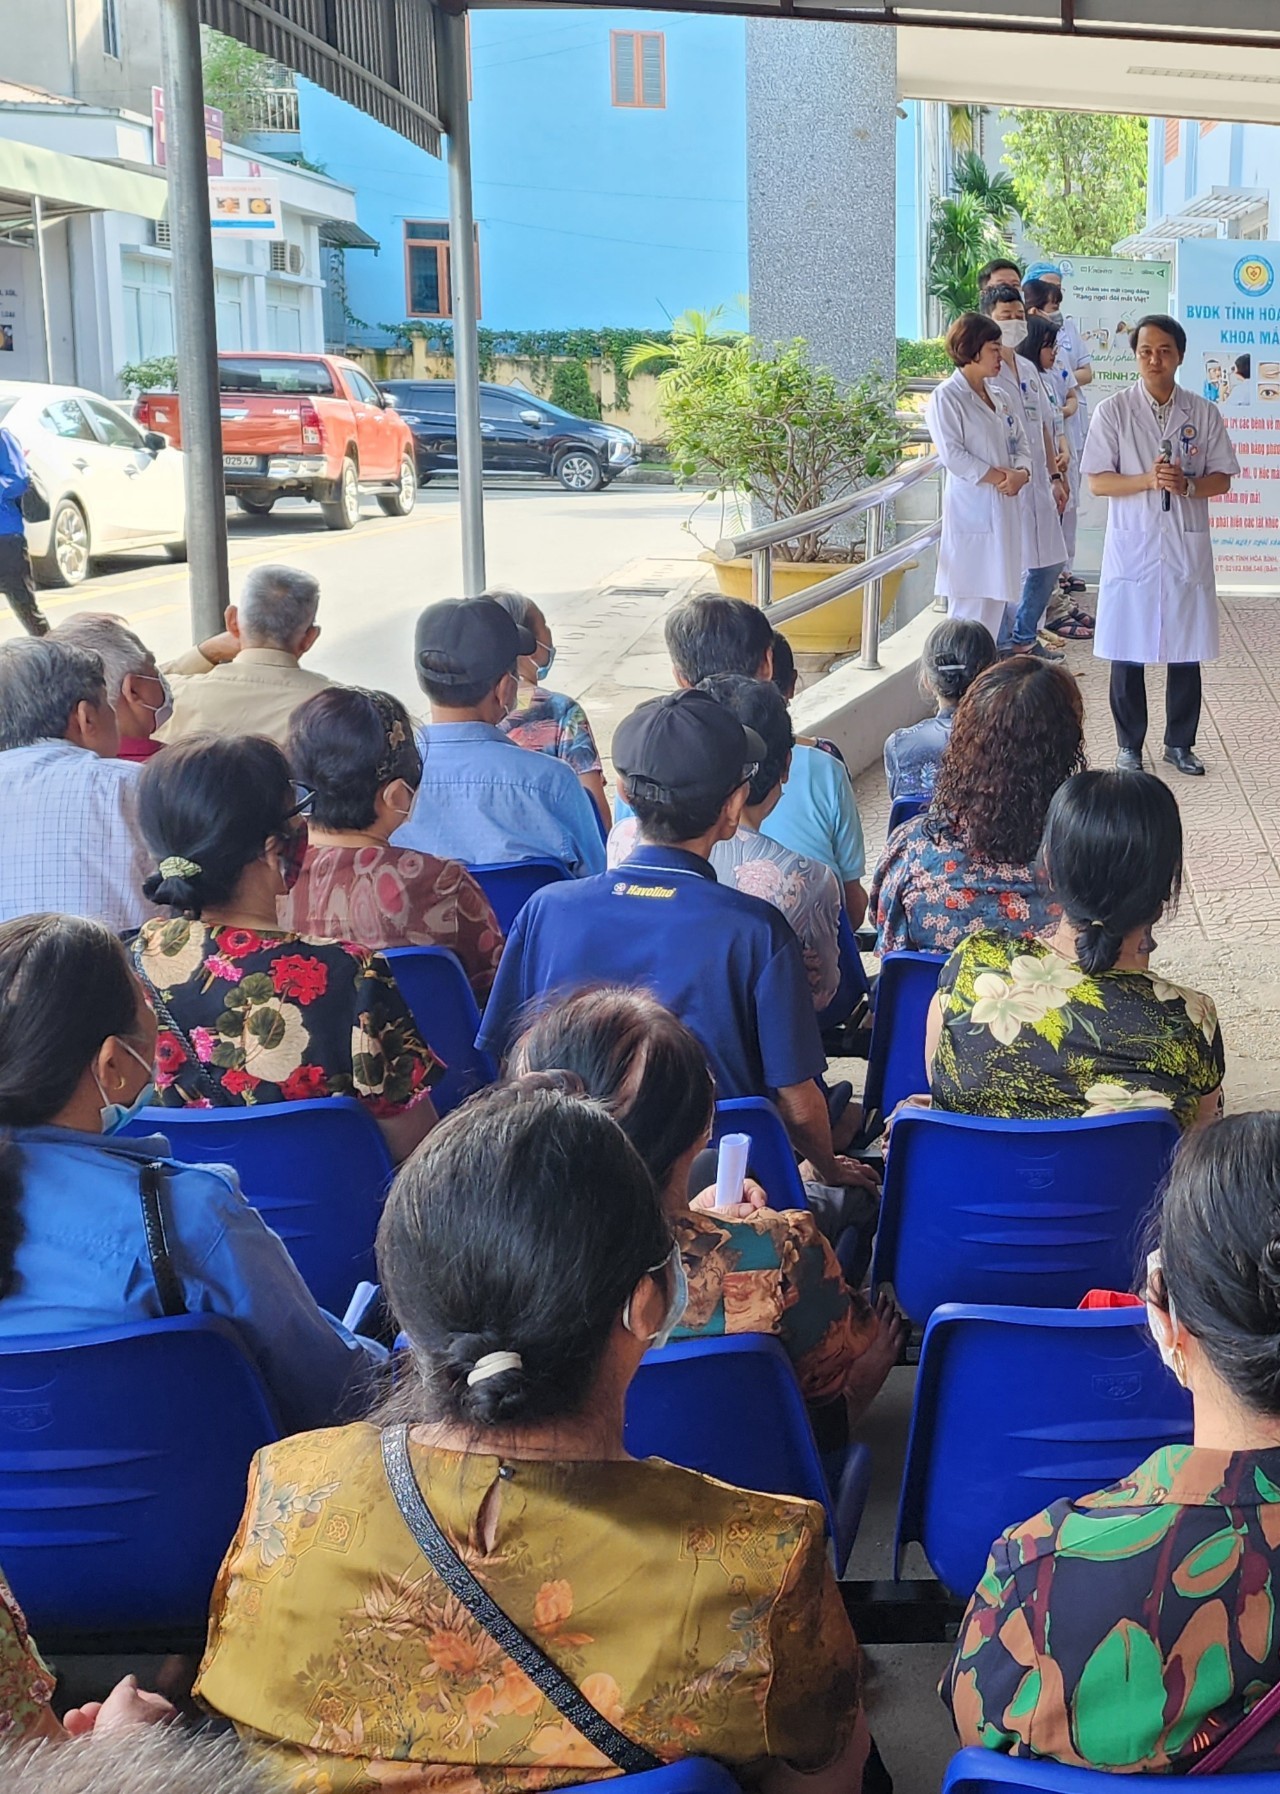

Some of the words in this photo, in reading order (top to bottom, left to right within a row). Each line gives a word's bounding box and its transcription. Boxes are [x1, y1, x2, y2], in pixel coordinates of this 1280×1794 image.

[1187, 305, 1220, 319] BVĐK
[1225, 302, 1254, 320] TỈNH
[1220, 330, 1254, 344] KHOA
[1097, 370, 1128, 380] TRÌNH
